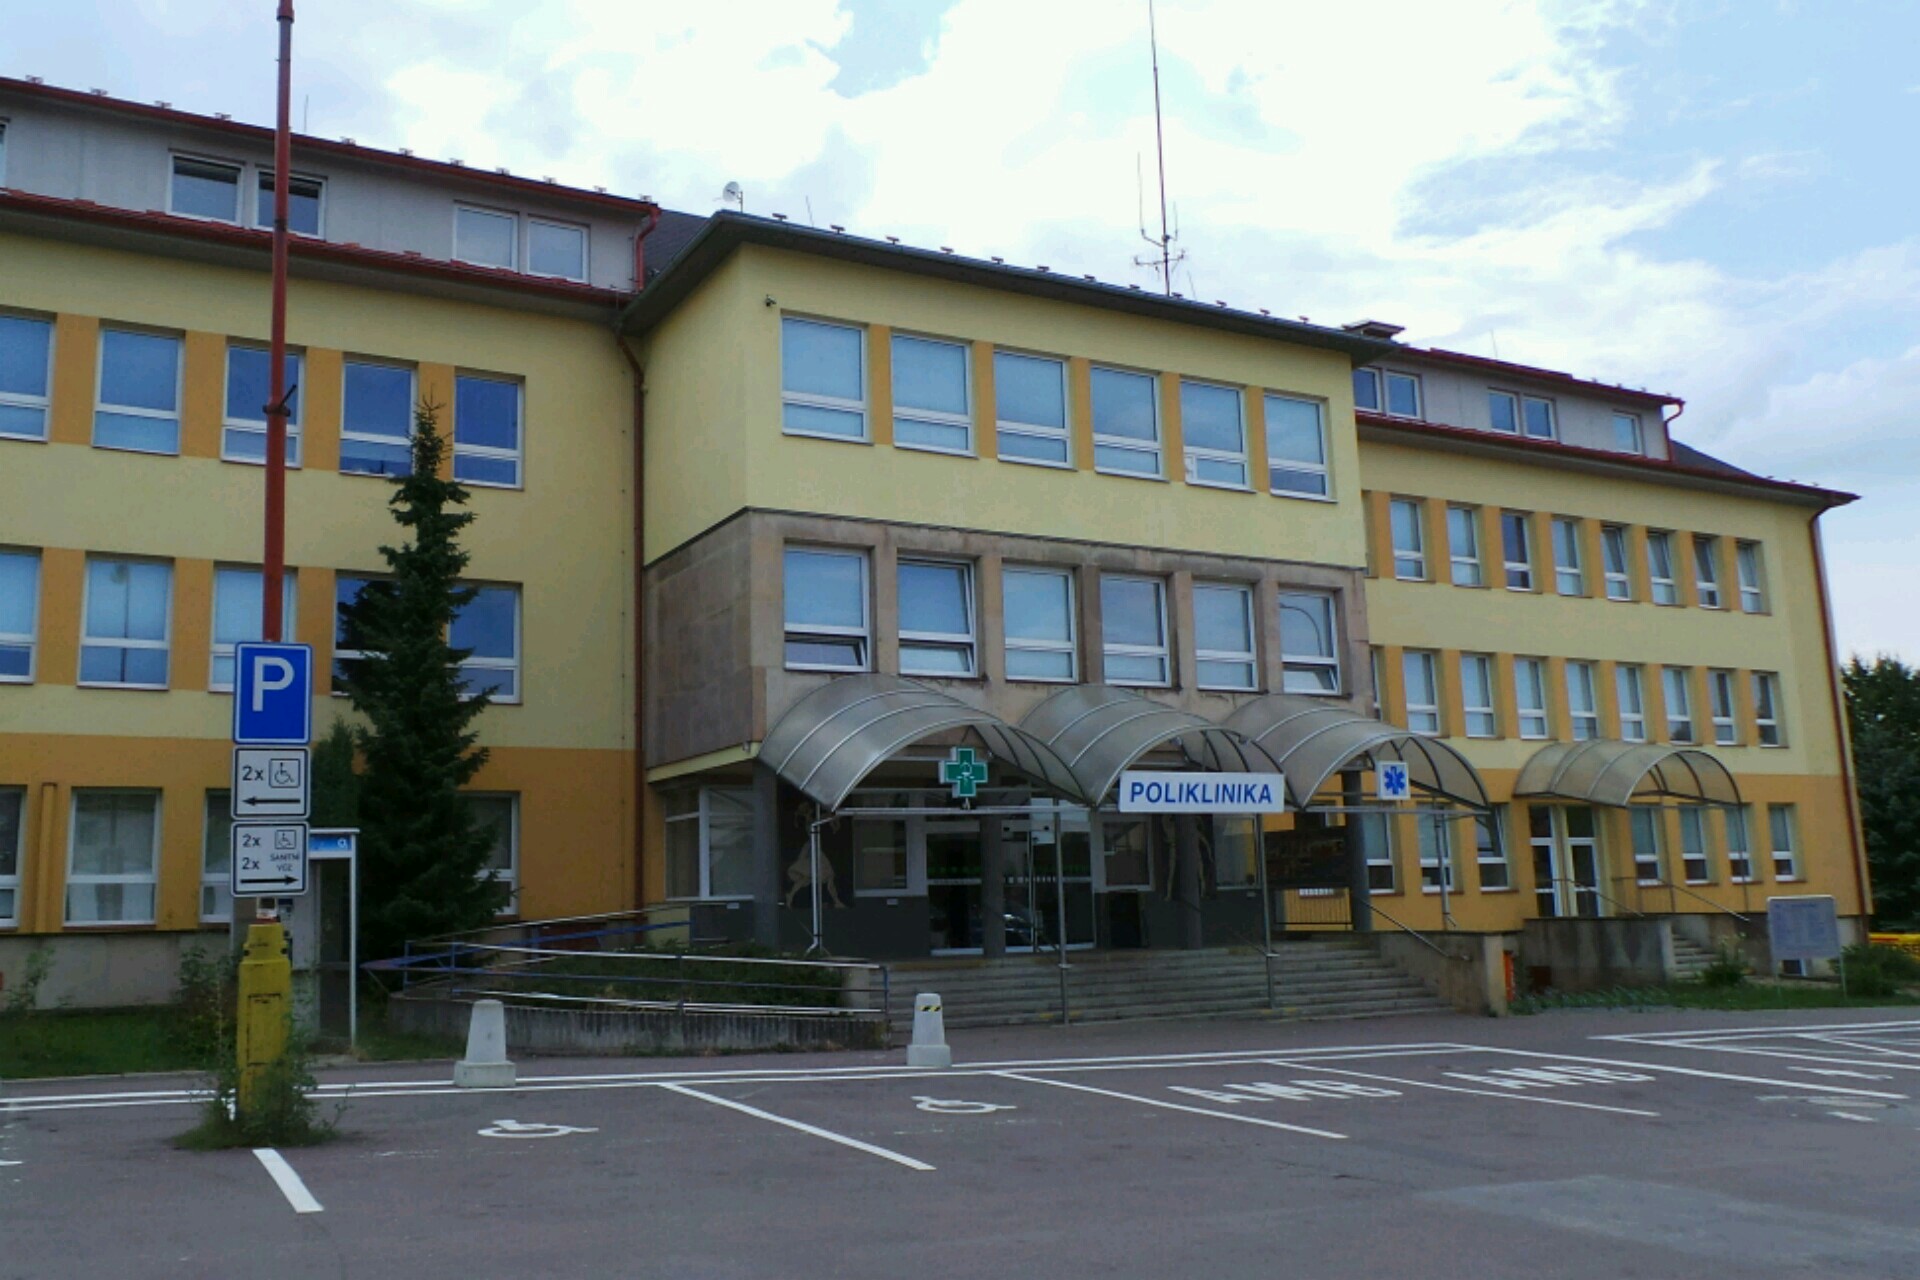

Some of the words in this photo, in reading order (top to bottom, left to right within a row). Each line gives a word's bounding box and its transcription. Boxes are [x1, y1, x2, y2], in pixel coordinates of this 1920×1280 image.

[252, 656, 294, 711] P
[242, 765, 264, 781] 2x
[1130, 782, 1272, 804] POLIKLINIKA
[242, 833, 261, 847] 2x
[242, 857, 260, 870] 2x
[1166, 1079, 1403, 1103] AMB
